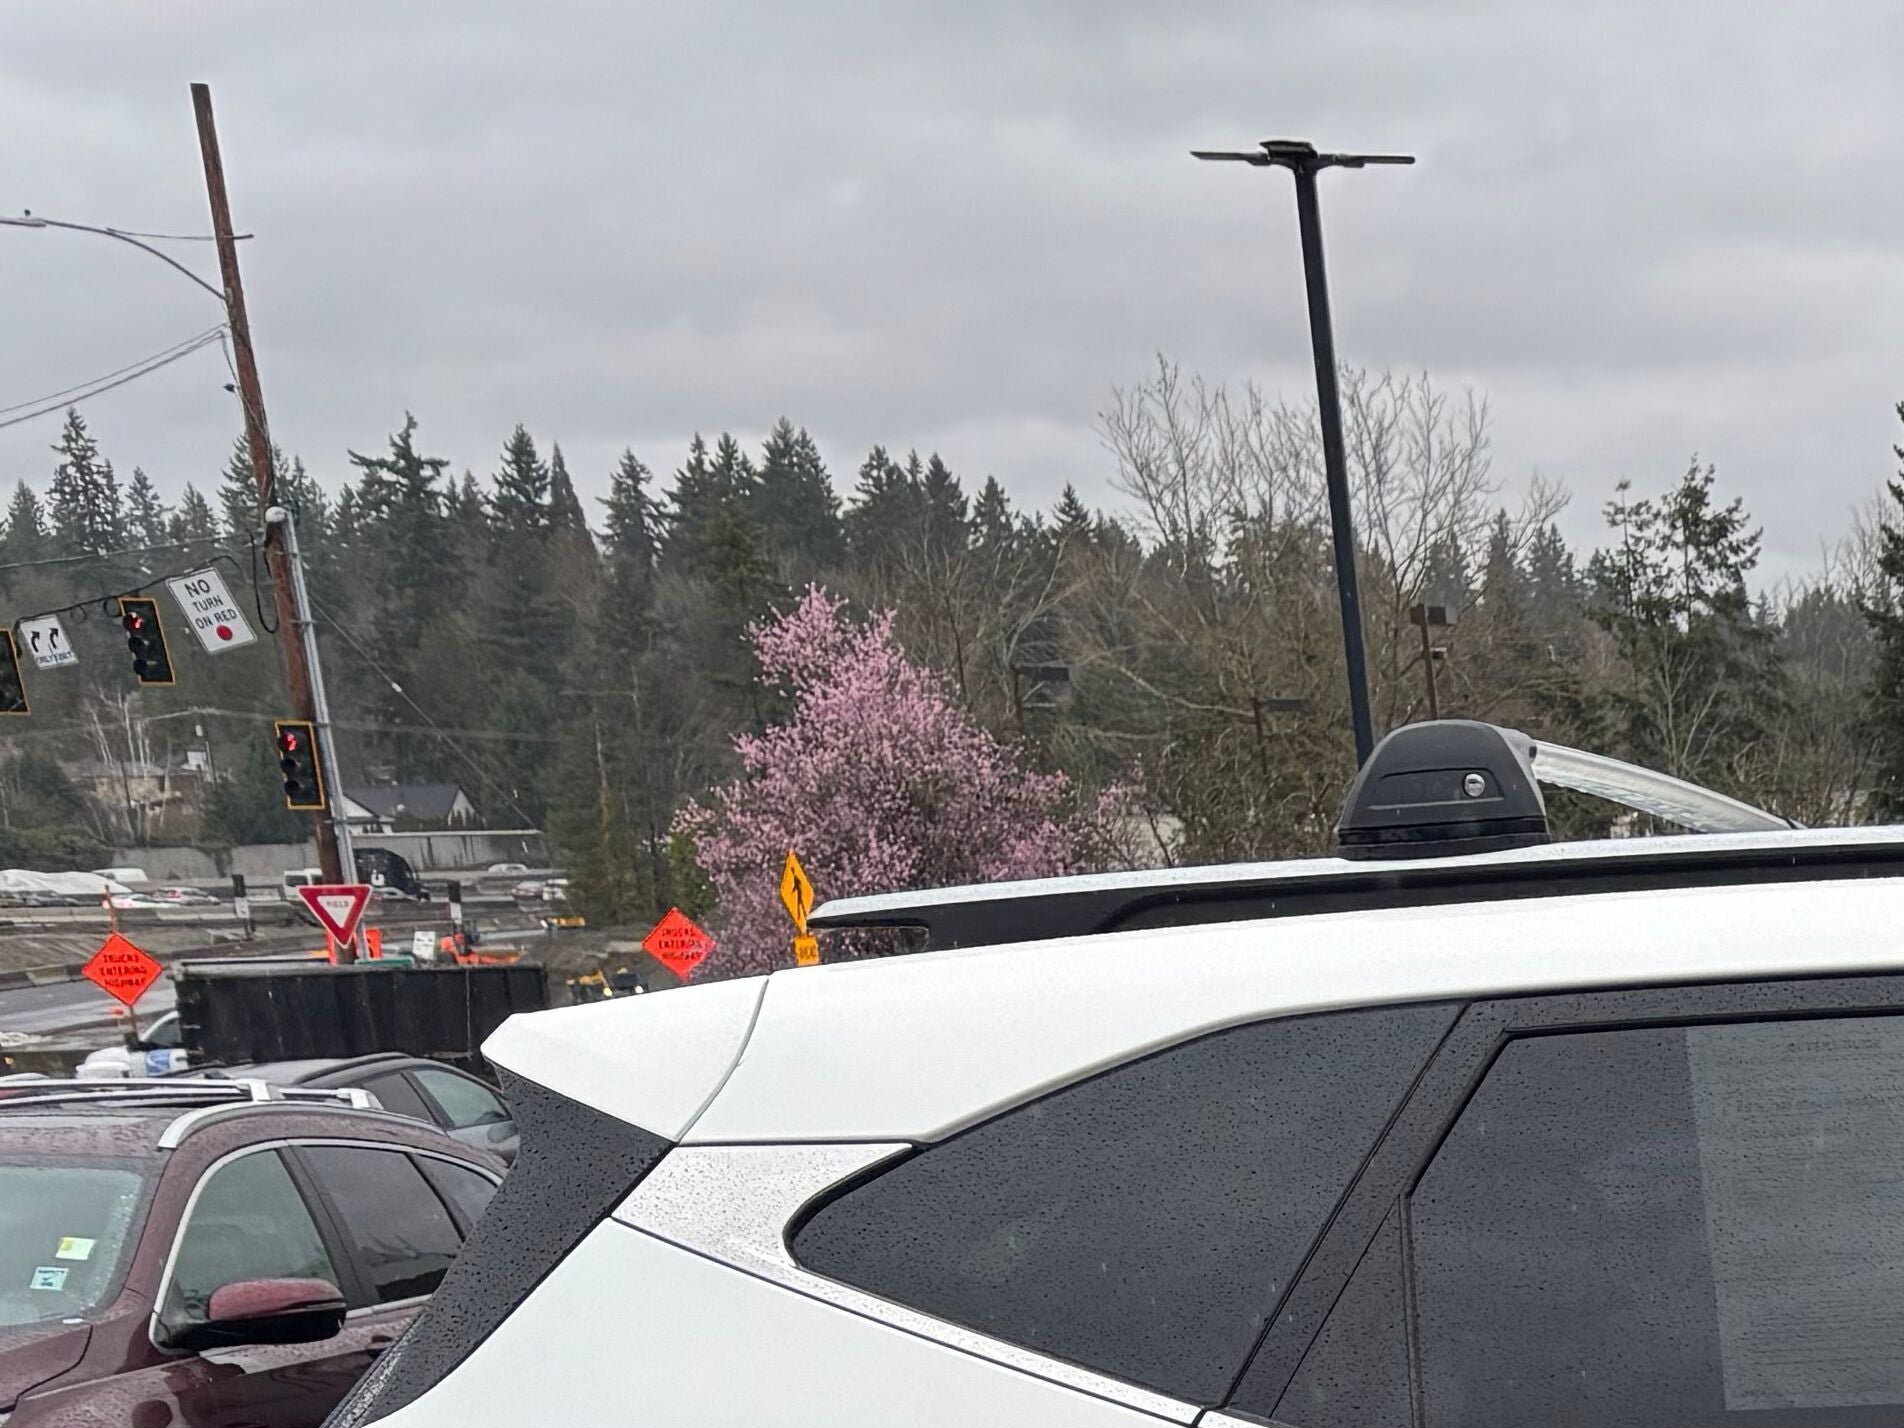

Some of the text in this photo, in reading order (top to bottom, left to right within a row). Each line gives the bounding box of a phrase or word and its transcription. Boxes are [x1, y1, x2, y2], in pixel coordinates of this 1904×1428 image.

[183, 577, 212, 599] NO
[191, 594, 224, 614] TURN
[195, 608, 238, 631] ON RED
